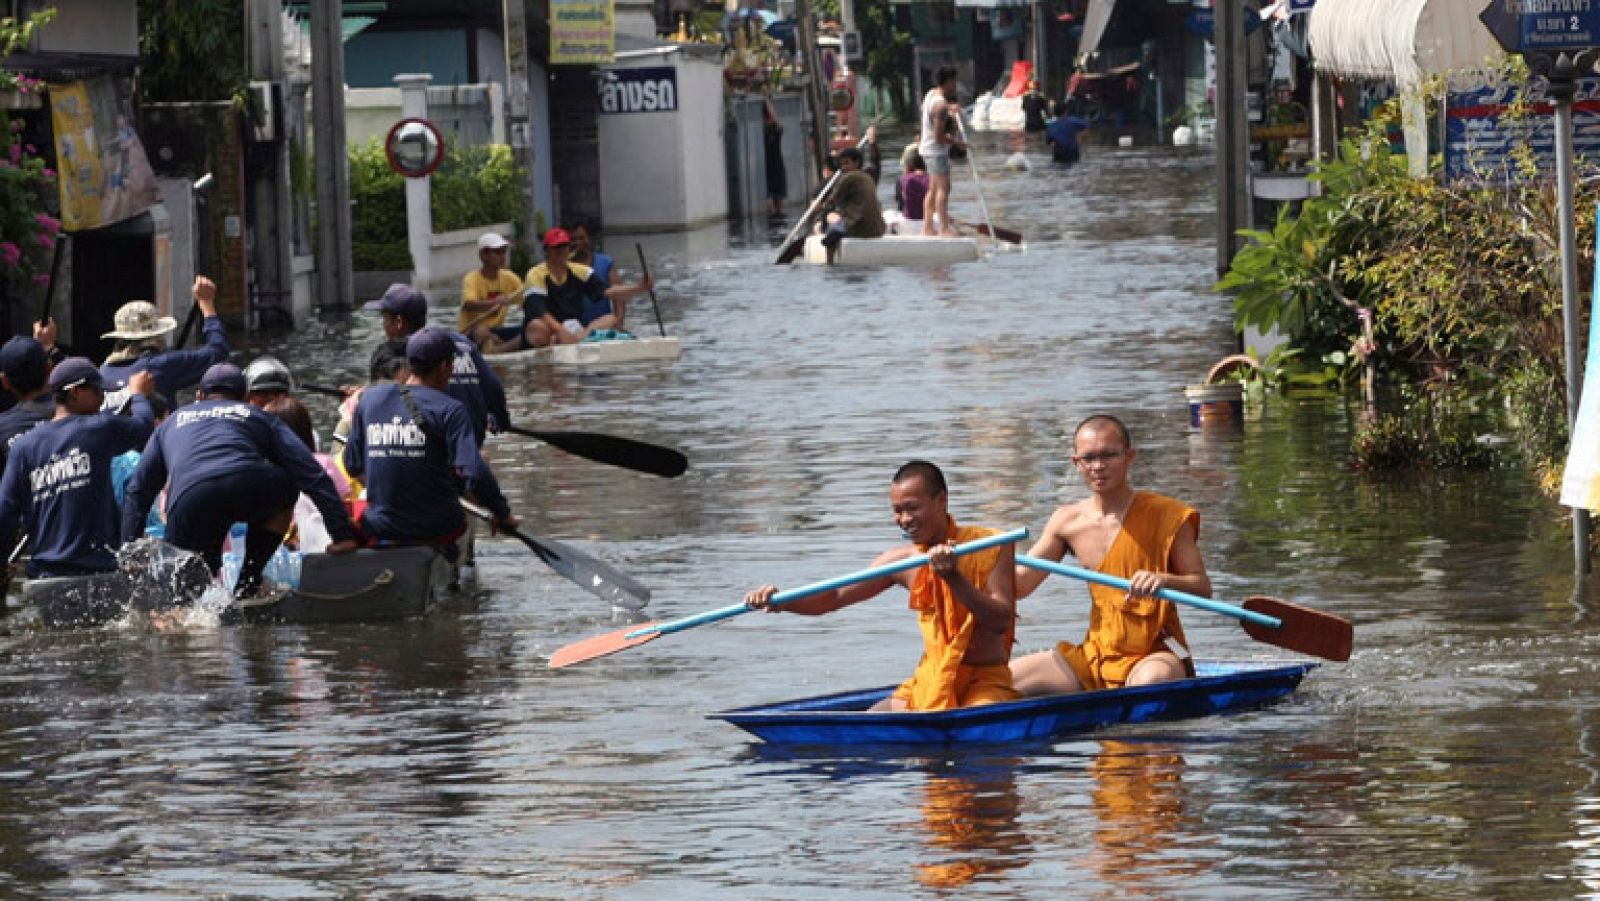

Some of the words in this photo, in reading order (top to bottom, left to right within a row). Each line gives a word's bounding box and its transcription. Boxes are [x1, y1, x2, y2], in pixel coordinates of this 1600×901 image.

[1570, 16, 1579, 30] 2
[601, 72, 673, 112] ล้างรถ
